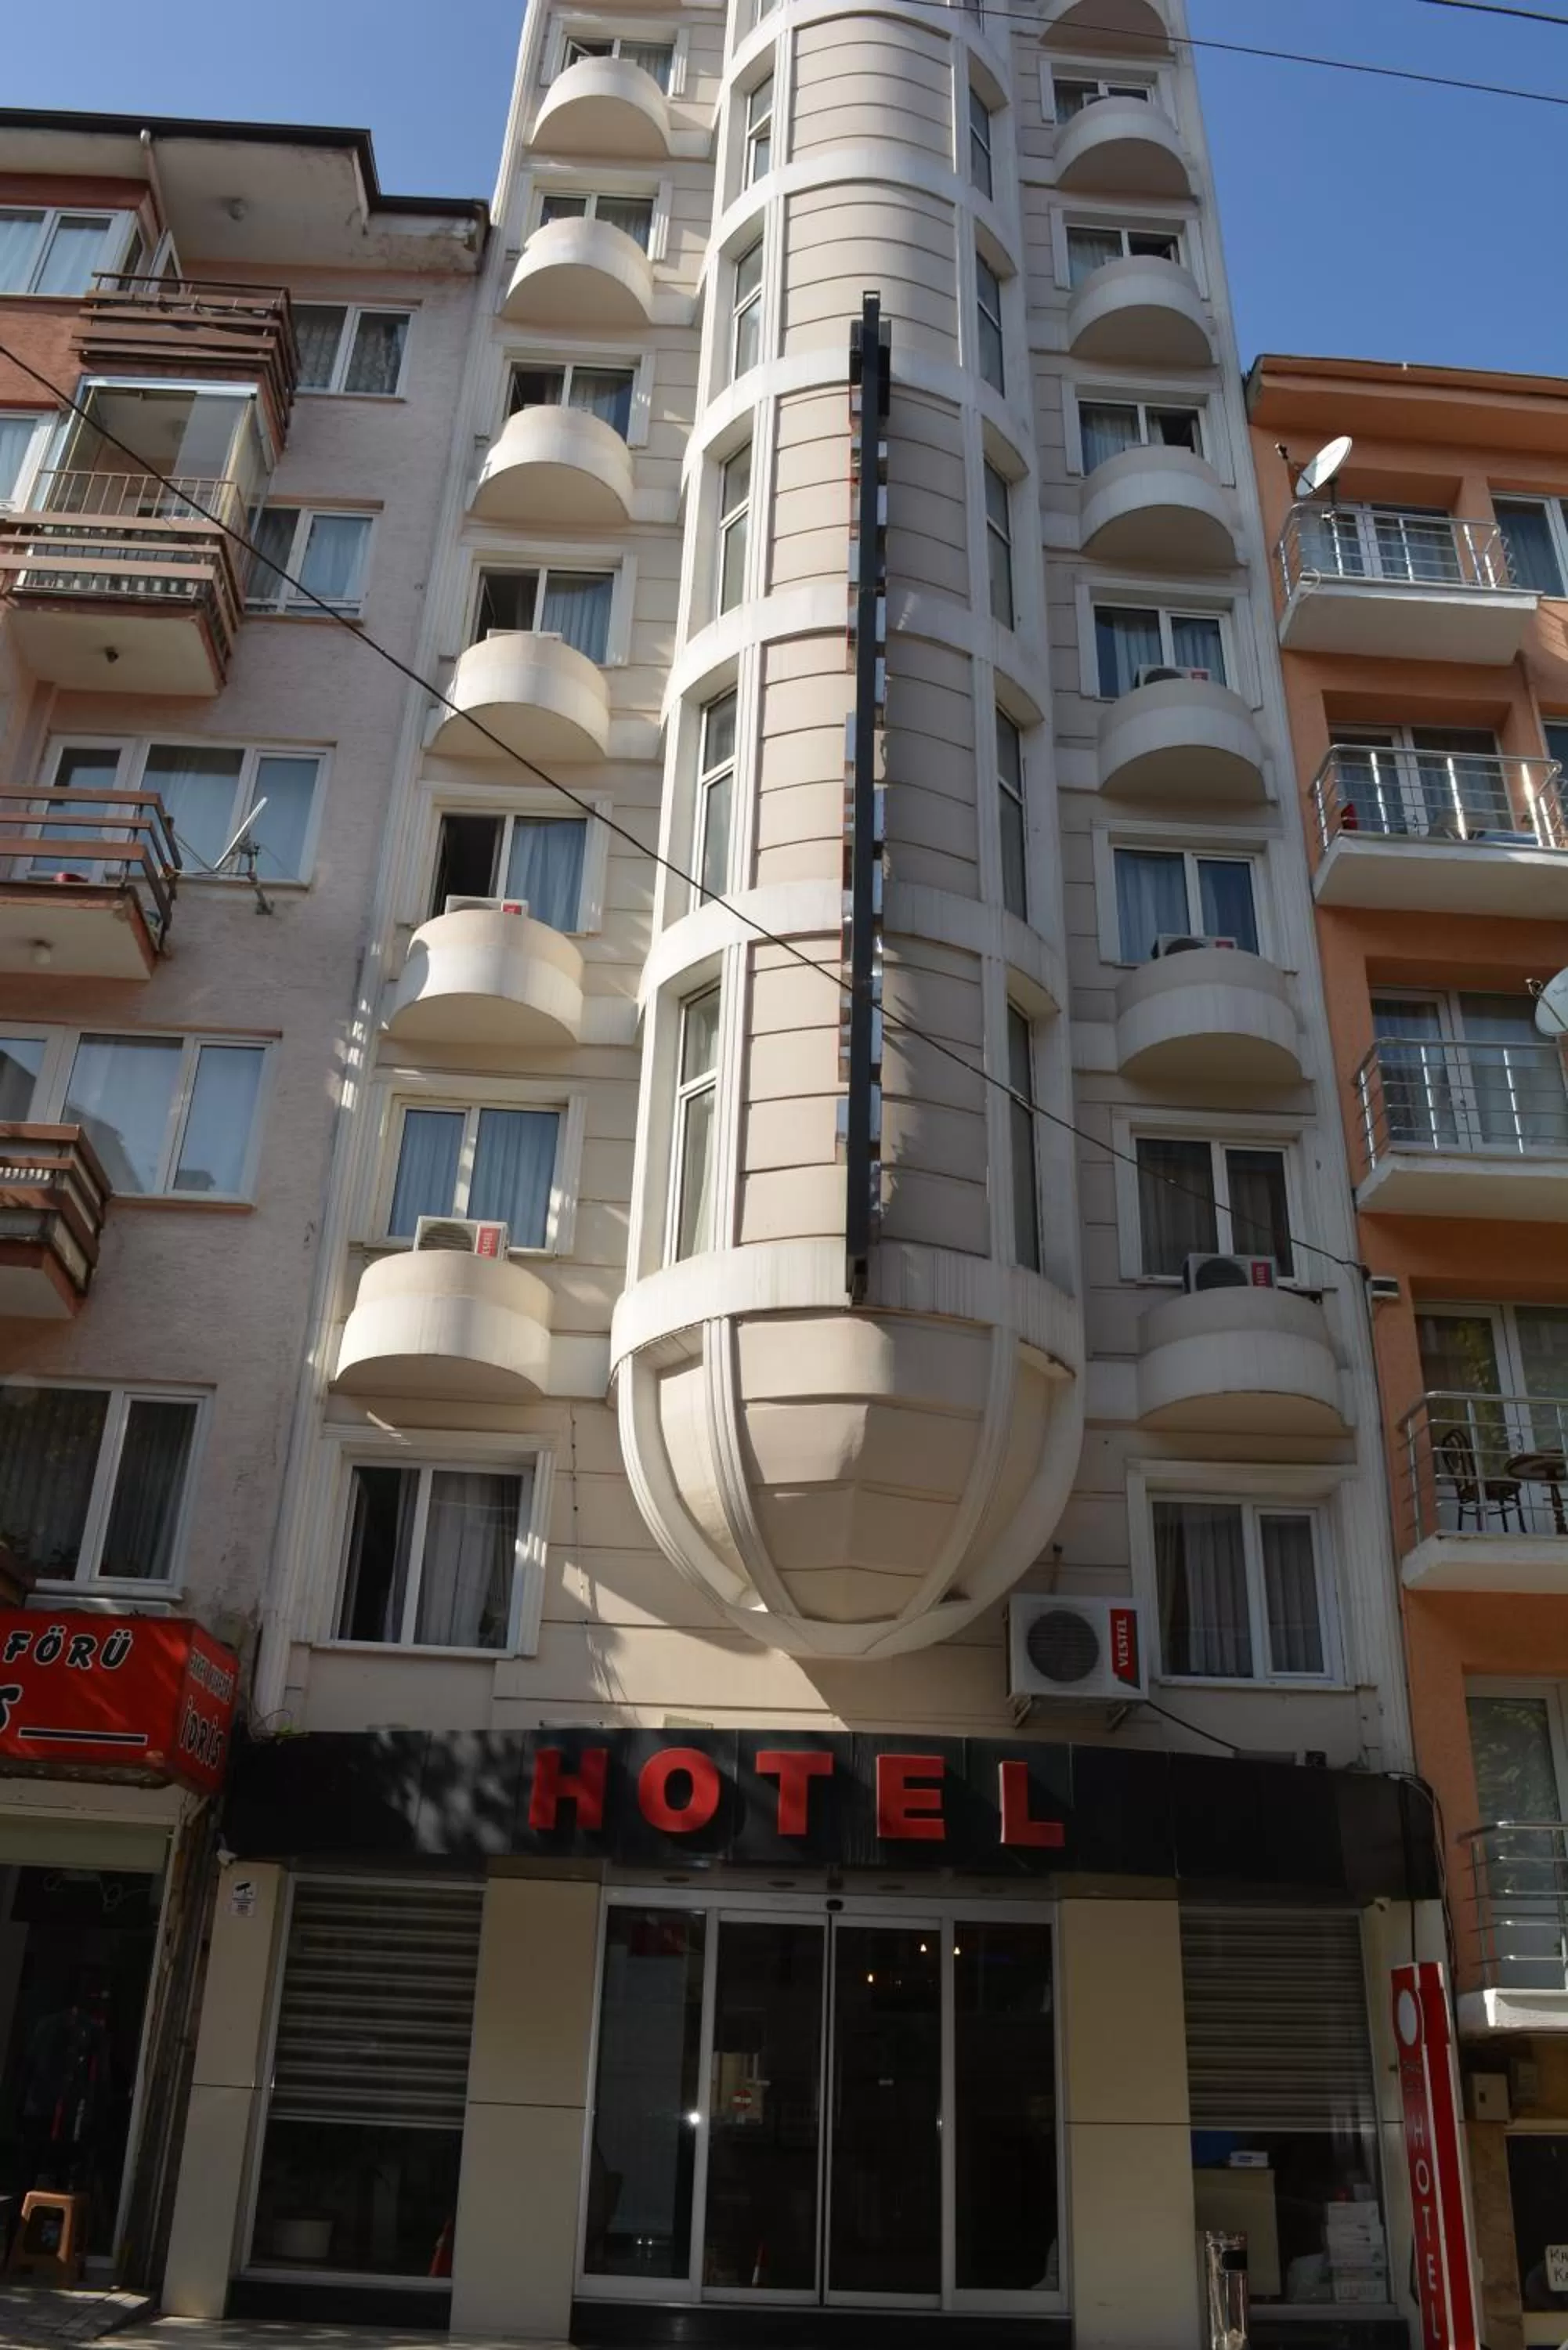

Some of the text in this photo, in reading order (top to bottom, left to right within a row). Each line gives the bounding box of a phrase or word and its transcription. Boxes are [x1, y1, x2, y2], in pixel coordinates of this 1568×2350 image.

[4, 1625, 133, 1669] FÖRÜ
[1115, 1617, 1129, 1668] VESTEL
[529, 1748, 1064, 1846] HOTEL
[1414, 2116, 1440, 2339] HOTEL
